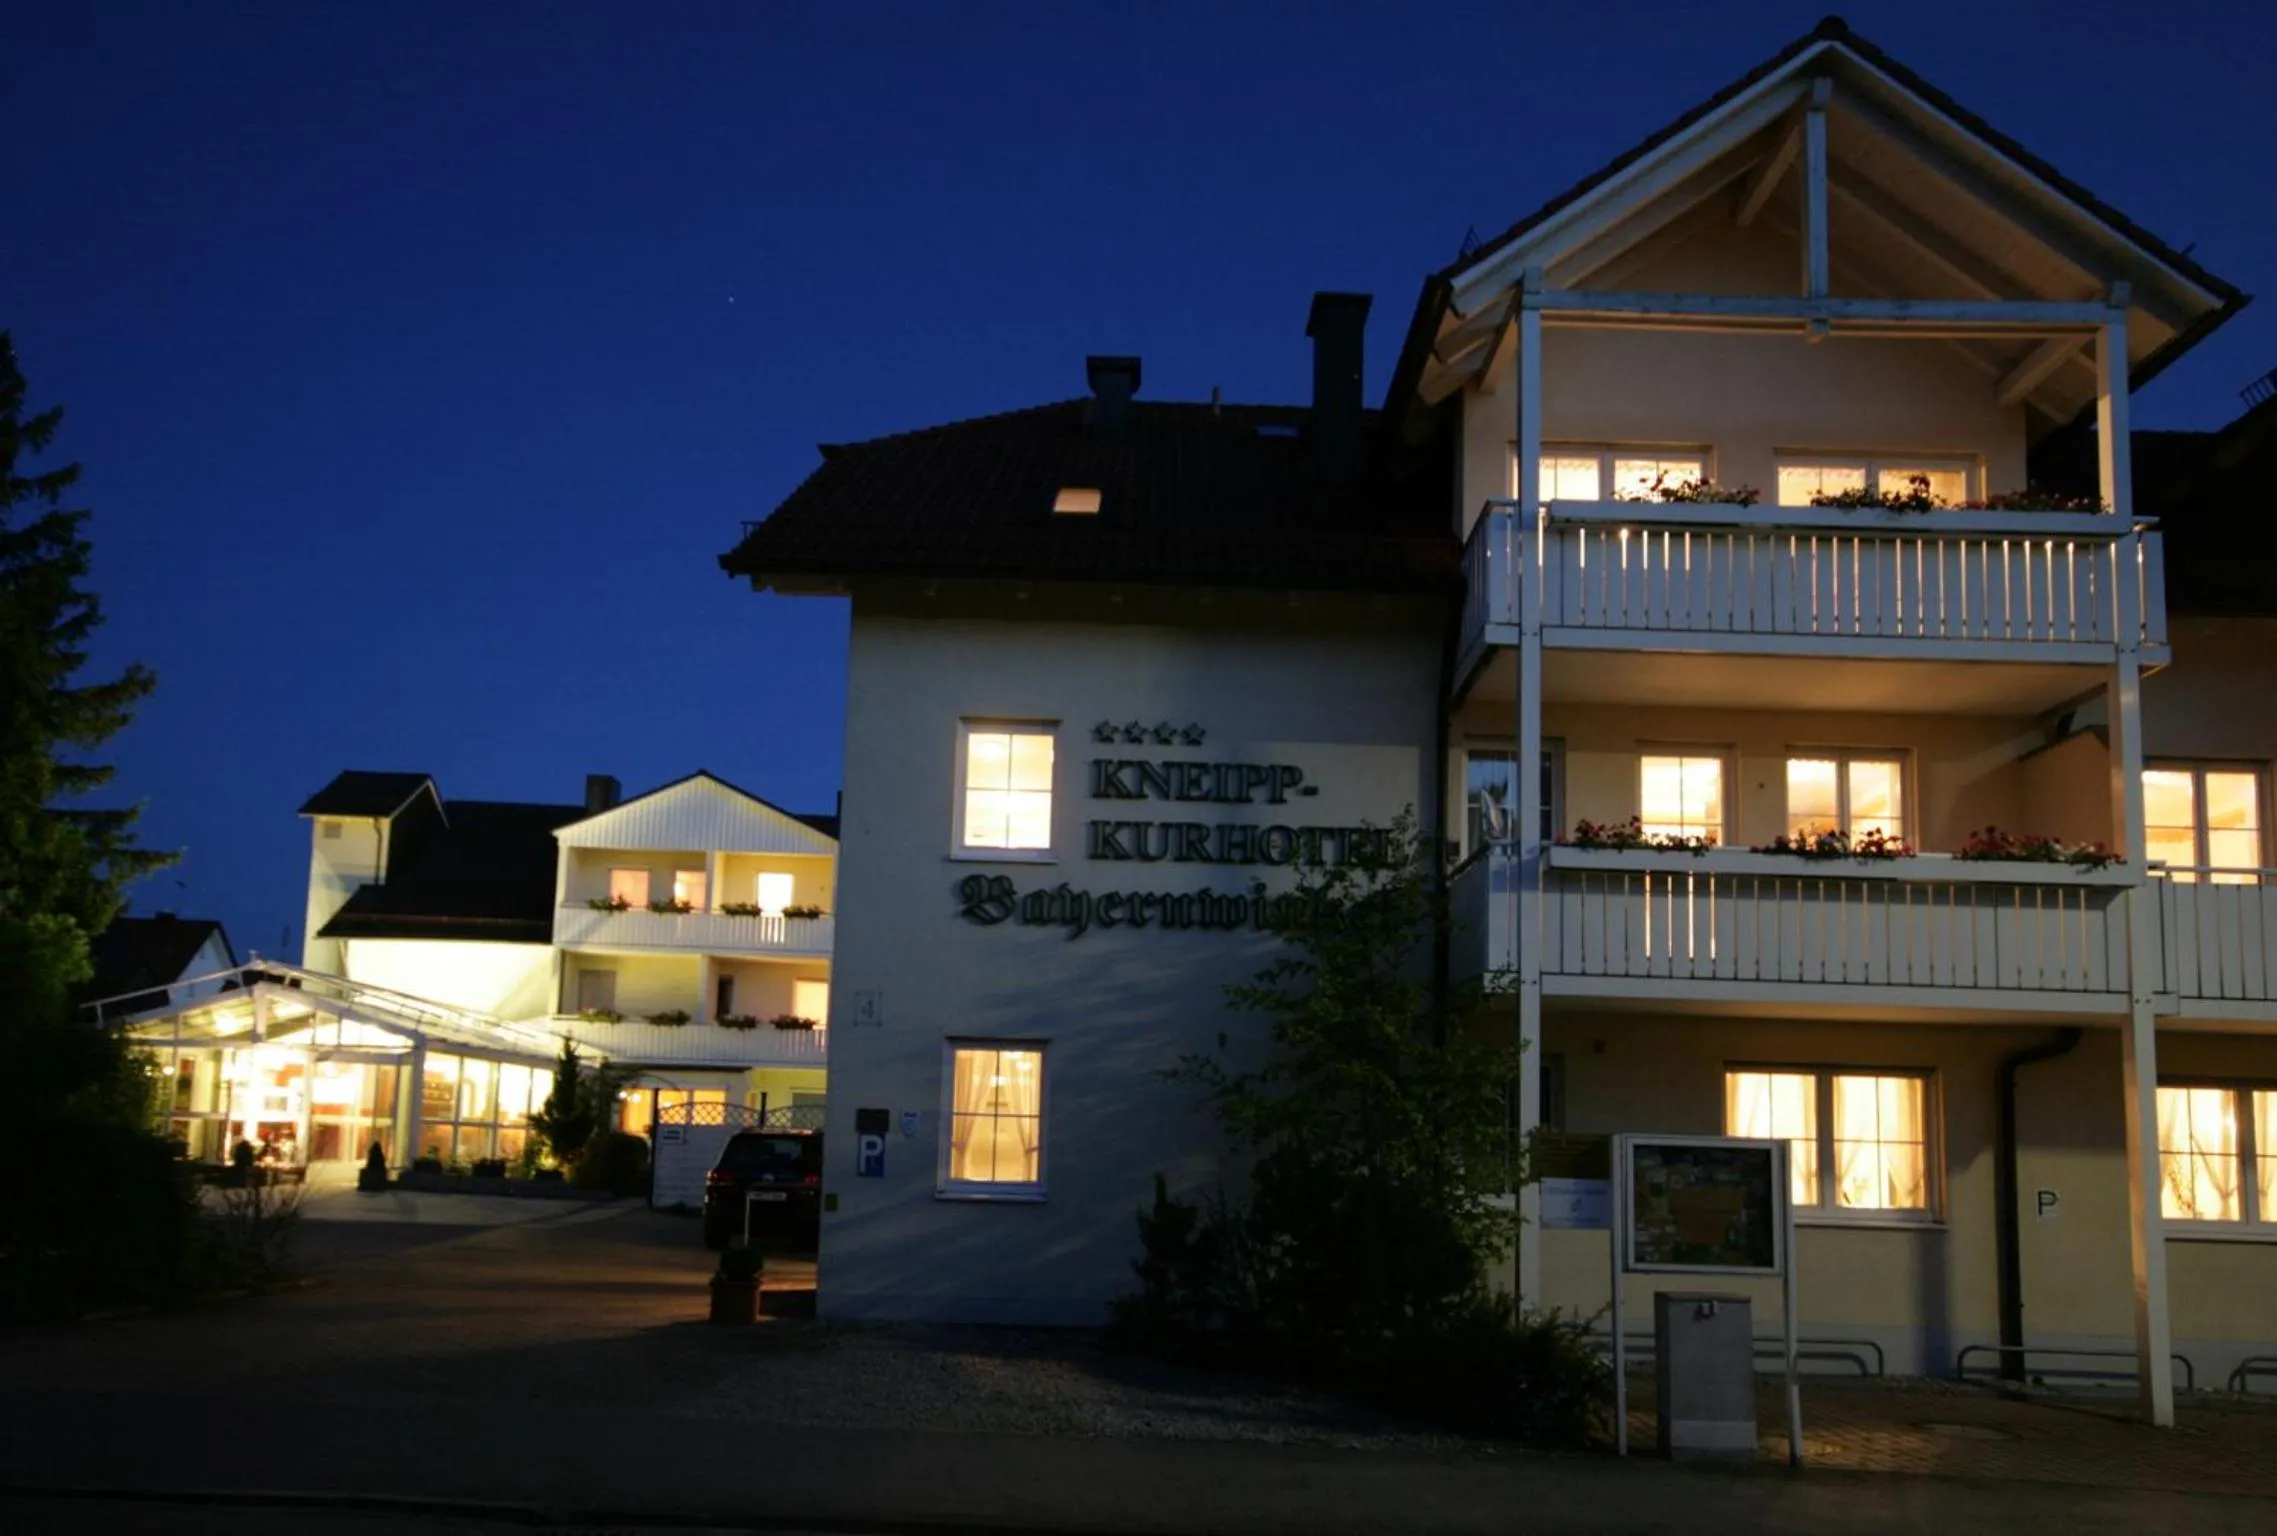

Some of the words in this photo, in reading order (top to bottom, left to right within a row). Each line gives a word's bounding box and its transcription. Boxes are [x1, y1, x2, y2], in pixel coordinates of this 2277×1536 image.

[1092, 758, 1318, 803] KNEIPP-
[860, 1134, 884, 1175] P
[2037, 1190, 2057, 1215] P
